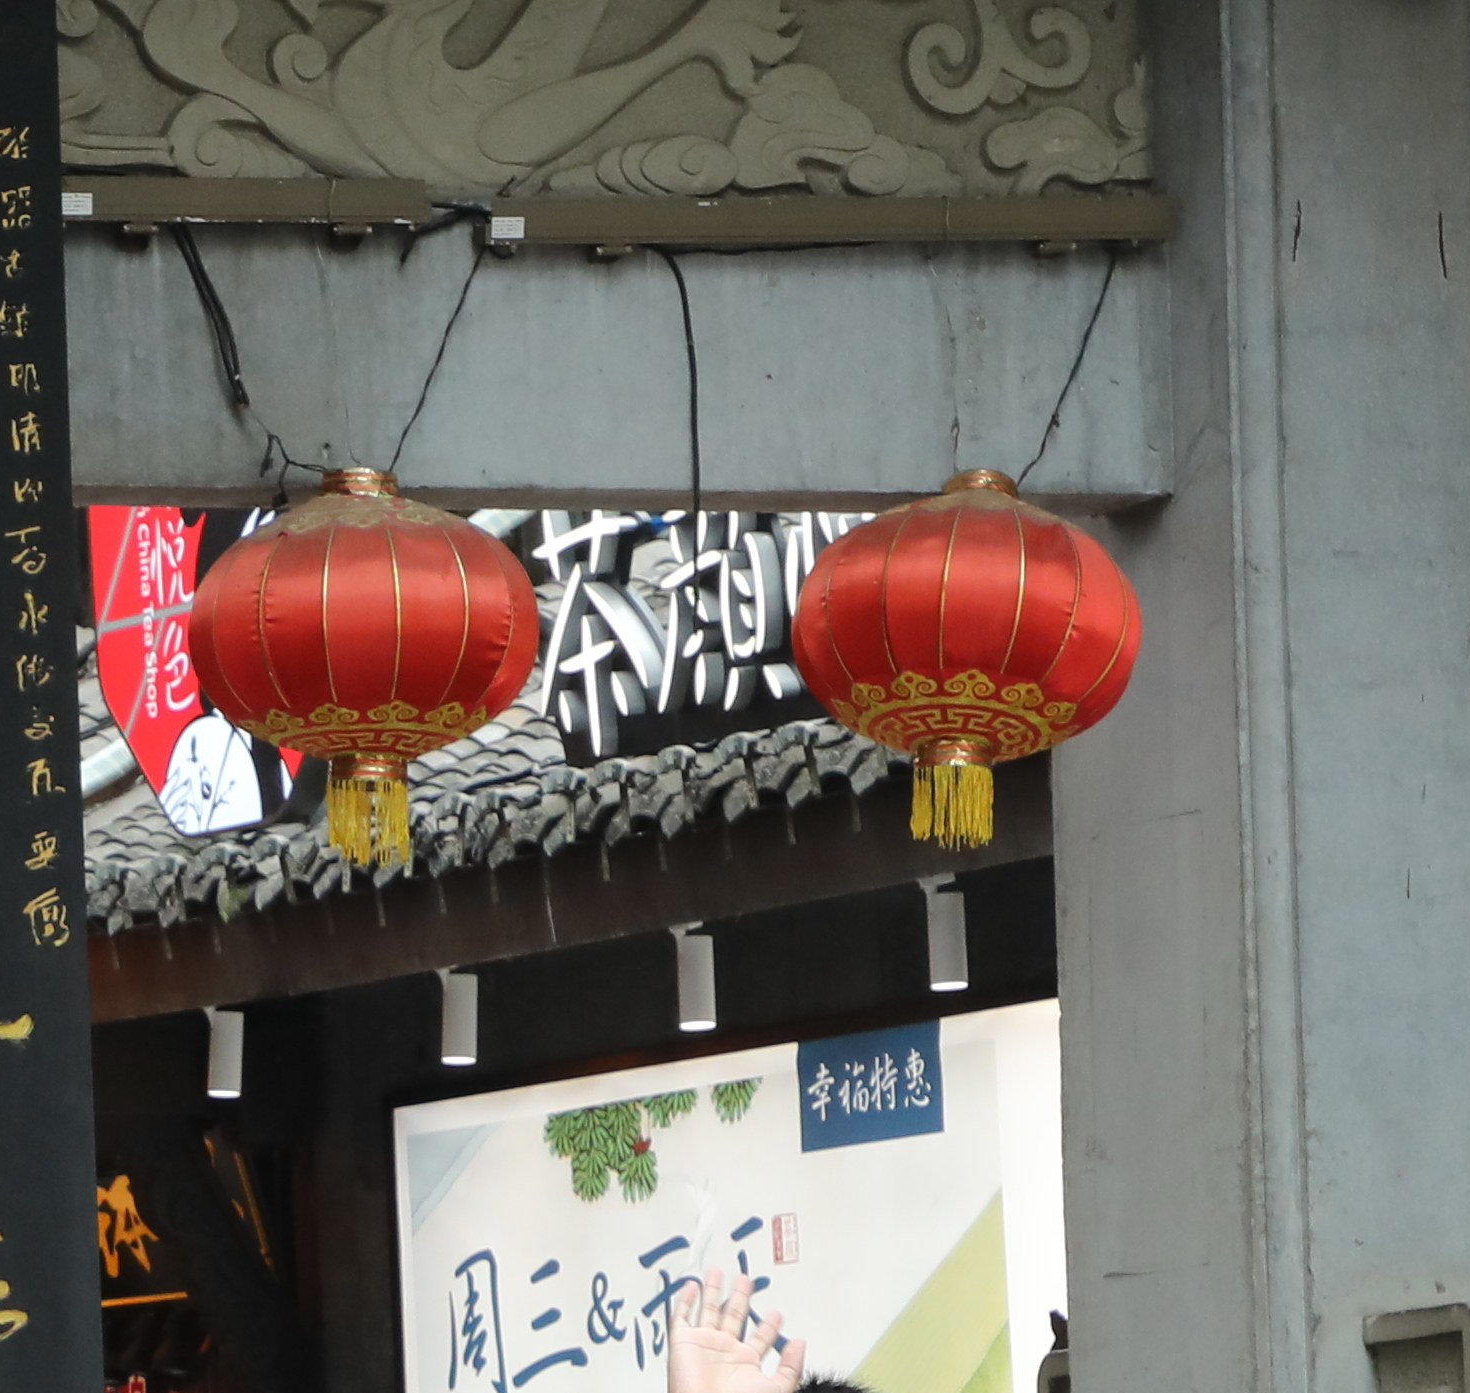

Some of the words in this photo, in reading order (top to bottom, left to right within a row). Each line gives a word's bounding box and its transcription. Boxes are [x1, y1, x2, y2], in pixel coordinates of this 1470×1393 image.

[137, 524, 152, 598] China
[141, 600, 155, 646] Tea
[143, 650, 160, 719] Shop
[807, 1047, 933, 1122] 幸福特惠
